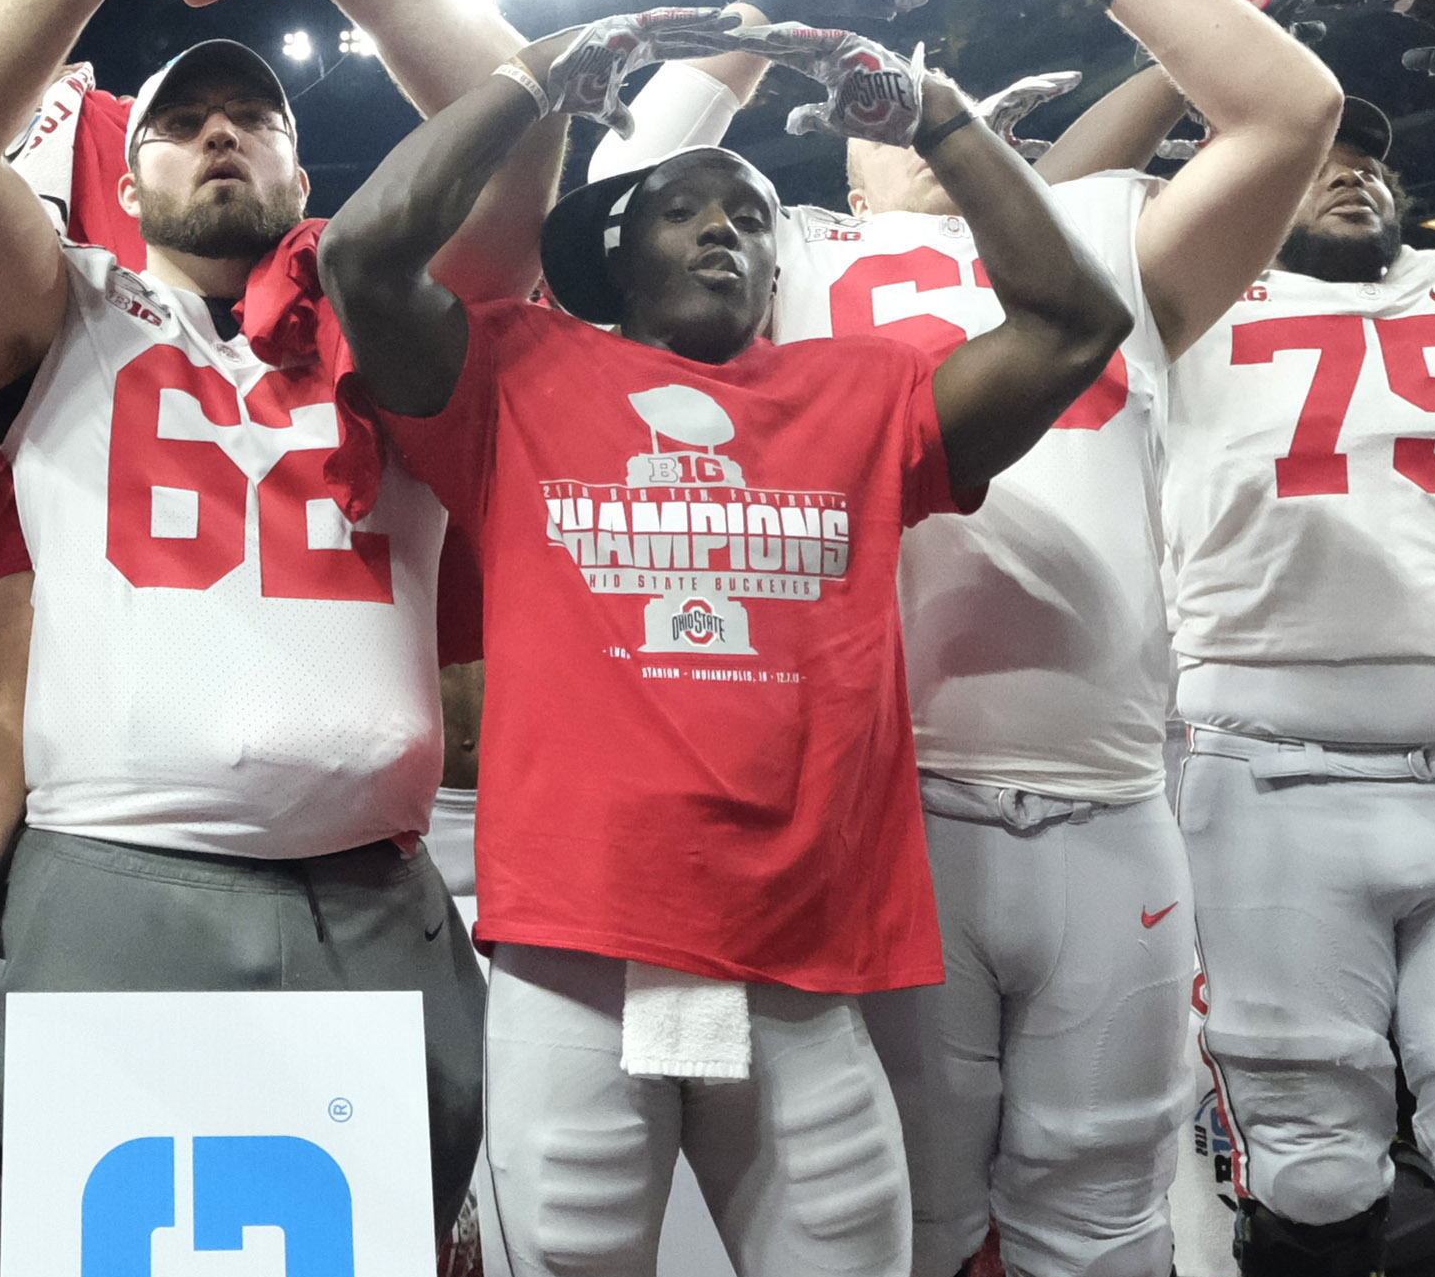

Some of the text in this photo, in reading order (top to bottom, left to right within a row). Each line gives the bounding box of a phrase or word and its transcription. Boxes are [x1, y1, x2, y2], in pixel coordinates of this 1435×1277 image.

[105, 343, 394, 605] 62
[730, 490, 838, 508] FOOTBALL
[589, 573, 810, 595] HIO STATE BUCKEYES
[641, 667, 680, 679] STADIUM
